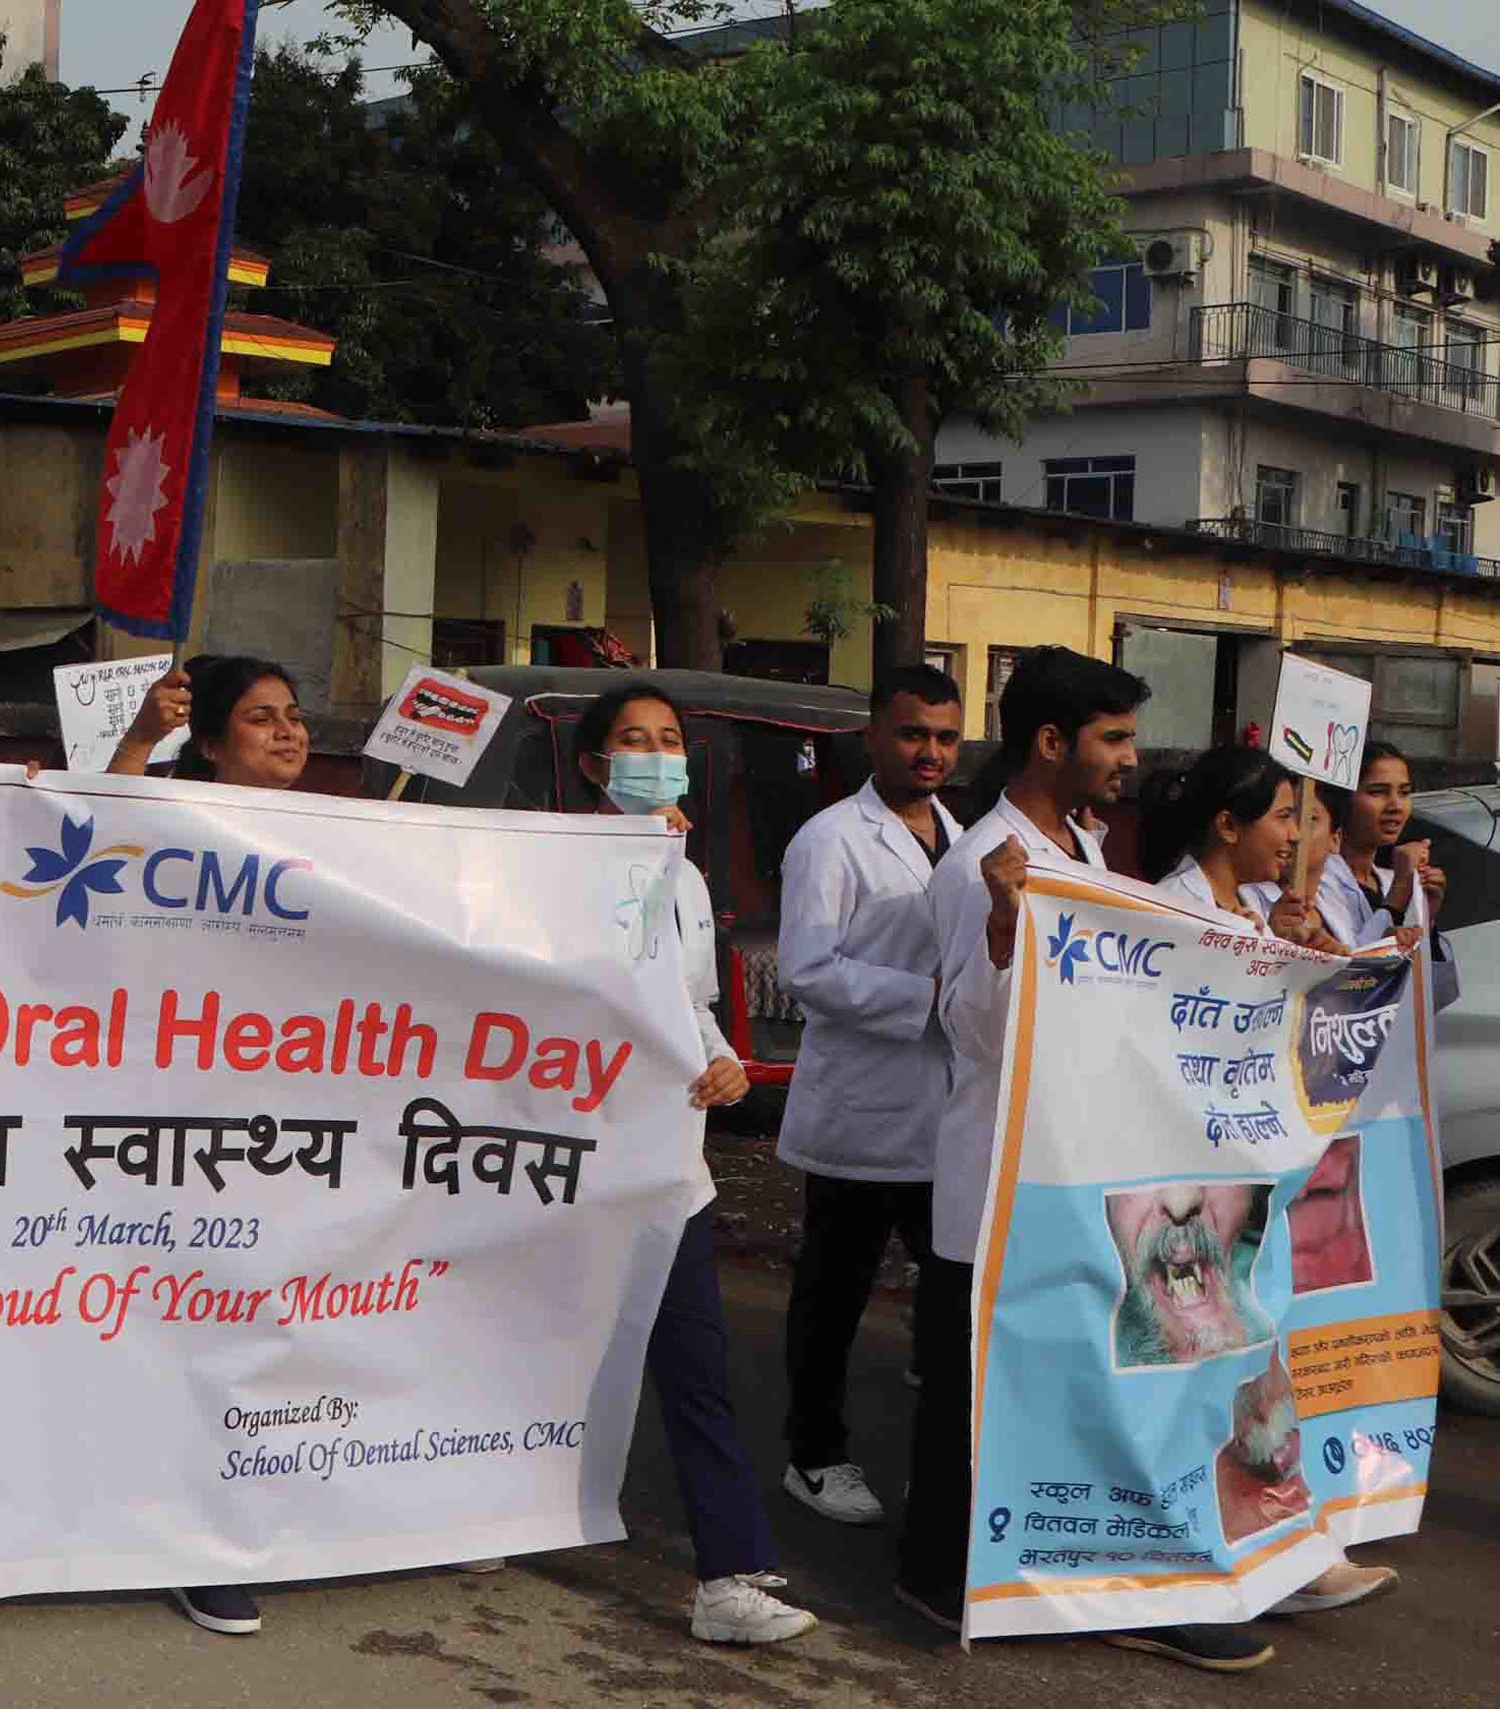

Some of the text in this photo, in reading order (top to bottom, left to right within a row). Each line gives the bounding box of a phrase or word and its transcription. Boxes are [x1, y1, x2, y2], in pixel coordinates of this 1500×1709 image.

[143, 848, 313, 920] CMC
[1096, 931, 1176, 977] CMC
[1170, 986, 1231, 1034] दाँत
[154, 988, 438, 1079] Health
[463, 1012, 633, 1113] Day
[1176, 1052, 1221, 1087] तथा
[63, 1114, 358, 1193] स्वास्थ्य
[398, 1097, 598, 1206] दिवस
[10, 1210, 260, 1253] 20th March, 2023
[80, 1265, 150, 1341] Of
[152, 1269, 272, 1325] Your
[224, 1395, 359, 1437] Organized By:
[220, 1420, 586, 1481] School Of Dental Sciences, CMC
[1023, 1511, 1099, 1536] चितवन
[1105, 1513, 1190, 1539] मेडिकल
[1018, 1548, 1097, 1569] भरतपुर
